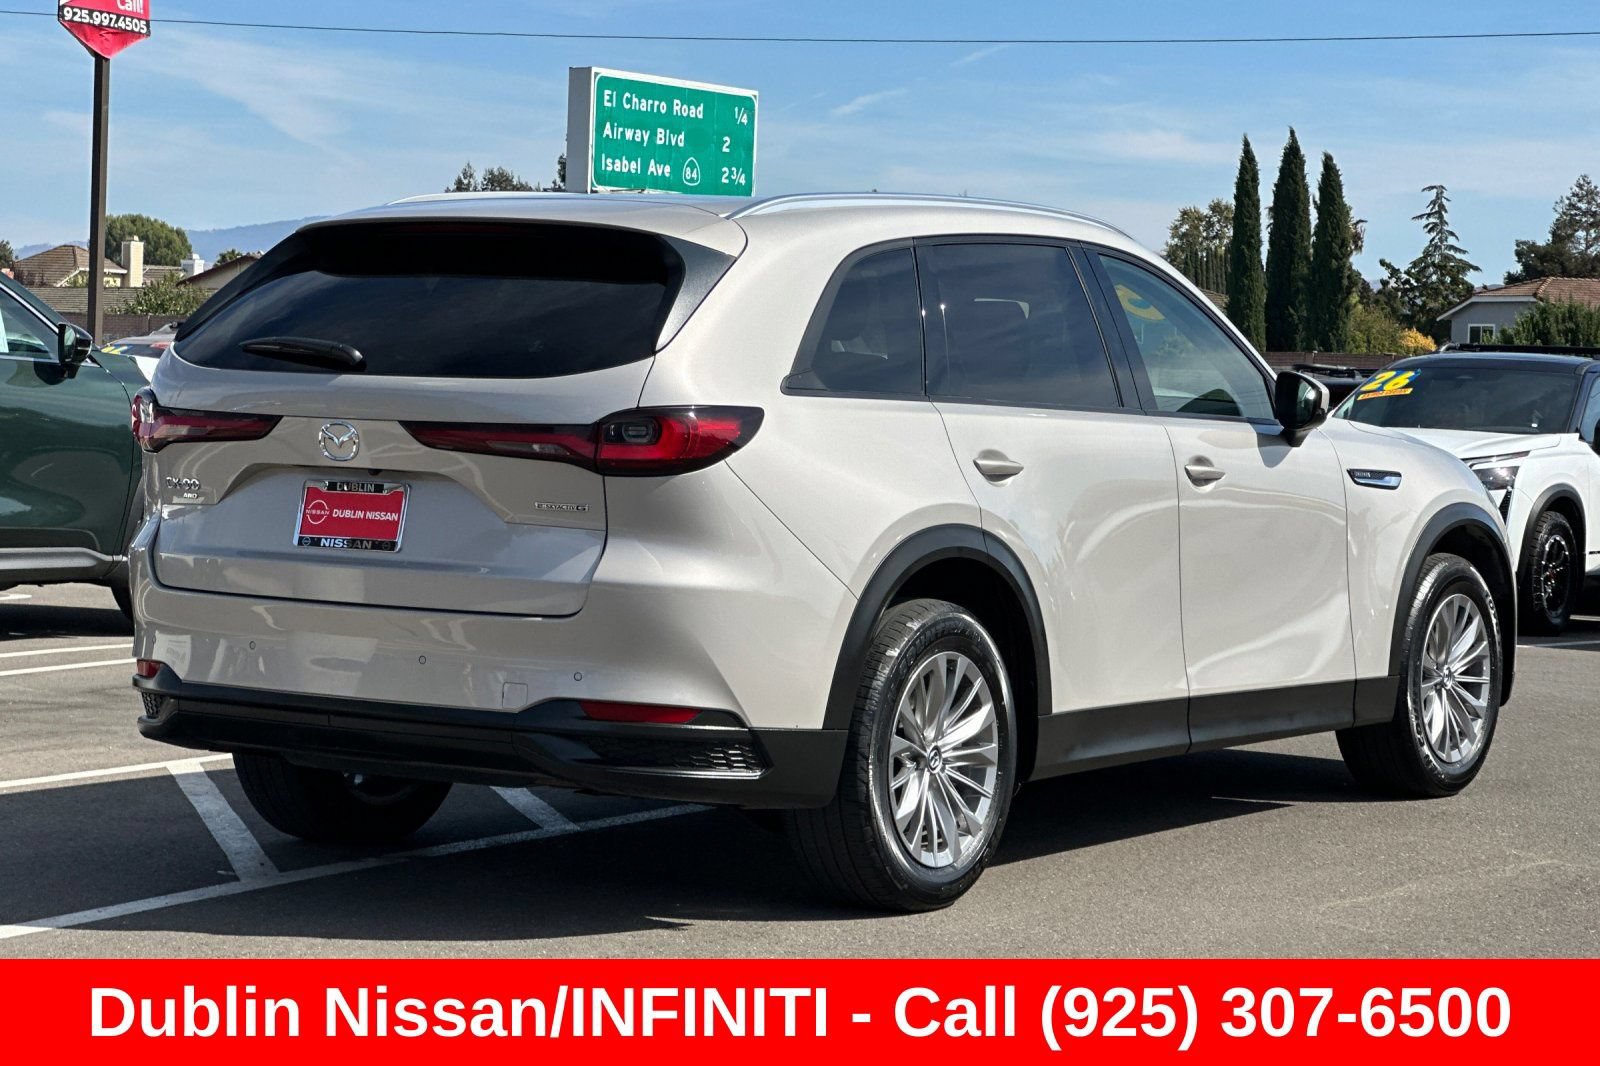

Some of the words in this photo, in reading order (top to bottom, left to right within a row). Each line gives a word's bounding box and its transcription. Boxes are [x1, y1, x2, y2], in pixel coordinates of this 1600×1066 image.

[63, 7, 148, 34] 925.997.4505
[603, 90, 617, 108] El
[622, 92, 668, 115] Charro
[673, 99, 704, 119] Road
[602, 122, 651, 147] Airway
[656, 128, 685, 147] Blvd
[721, 136, 731, 152] 2
[601, 153, 641, 175] Isabel
[647, 158, 671, 177] Ave
[685, 166, 698, 181] 84
[1359, 370, 1416, 392] 26
[166, 476, 200, 490] CX-90
[336, 482, 375, 493] DUBLIN
[332, 508, 365, 519] DUBLIN
[365, 510, 399, 522] NISSAN
[320, 537, 372, 549] NISSAN
